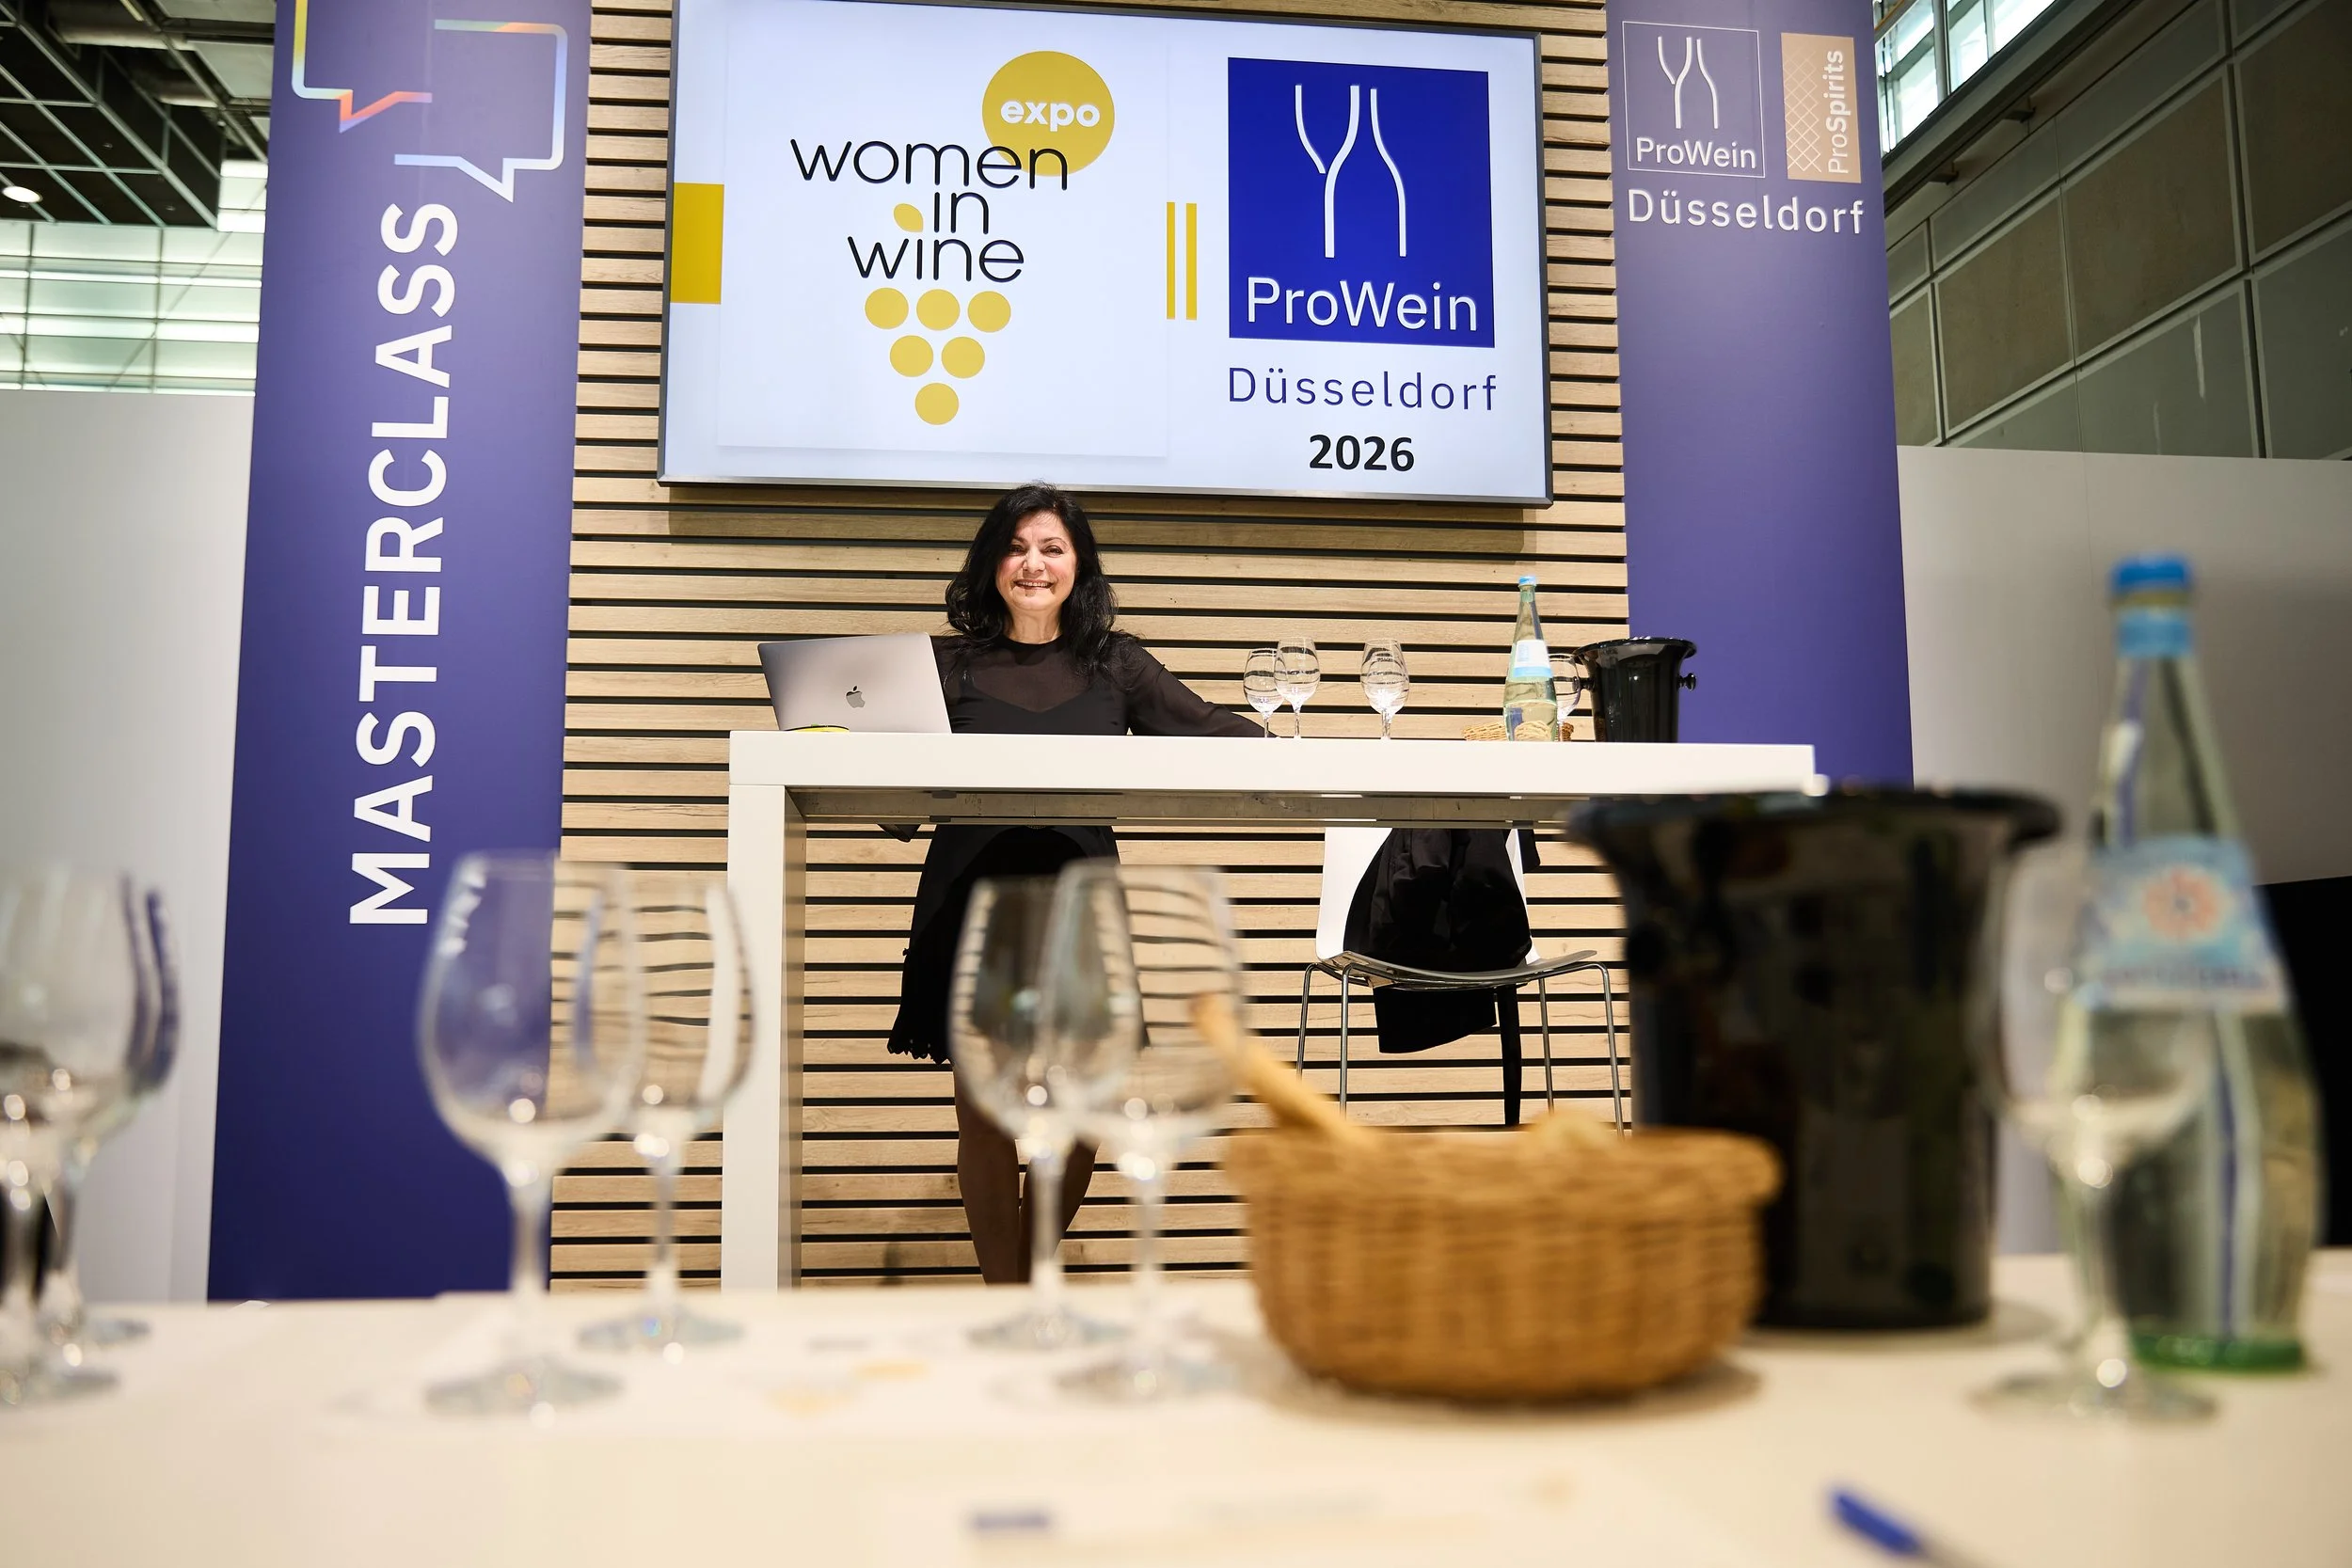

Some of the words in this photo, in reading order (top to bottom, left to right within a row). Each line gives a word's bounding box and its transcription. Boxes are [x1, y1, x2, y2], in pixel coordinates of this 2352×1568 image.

[1000, 99, 1101, 133] expo
[1822, 50, 1851, 174] ProSpirits
[790, 138, 1068, 191] women
[1635, 136, 1756, 169] ProWein
[933, 191, 989, 234] in
[1628, 188, 1864, 234] Düsseldorf
[847, 236, 1025, 283] wine
[1247, 277, 1477, 332] ProWein
[1229, 367, 1497, 411] Düsseldorf
[1309, 434, 1415, 472] 2026
[349, 202, 459, 925] MASTERCLASS
